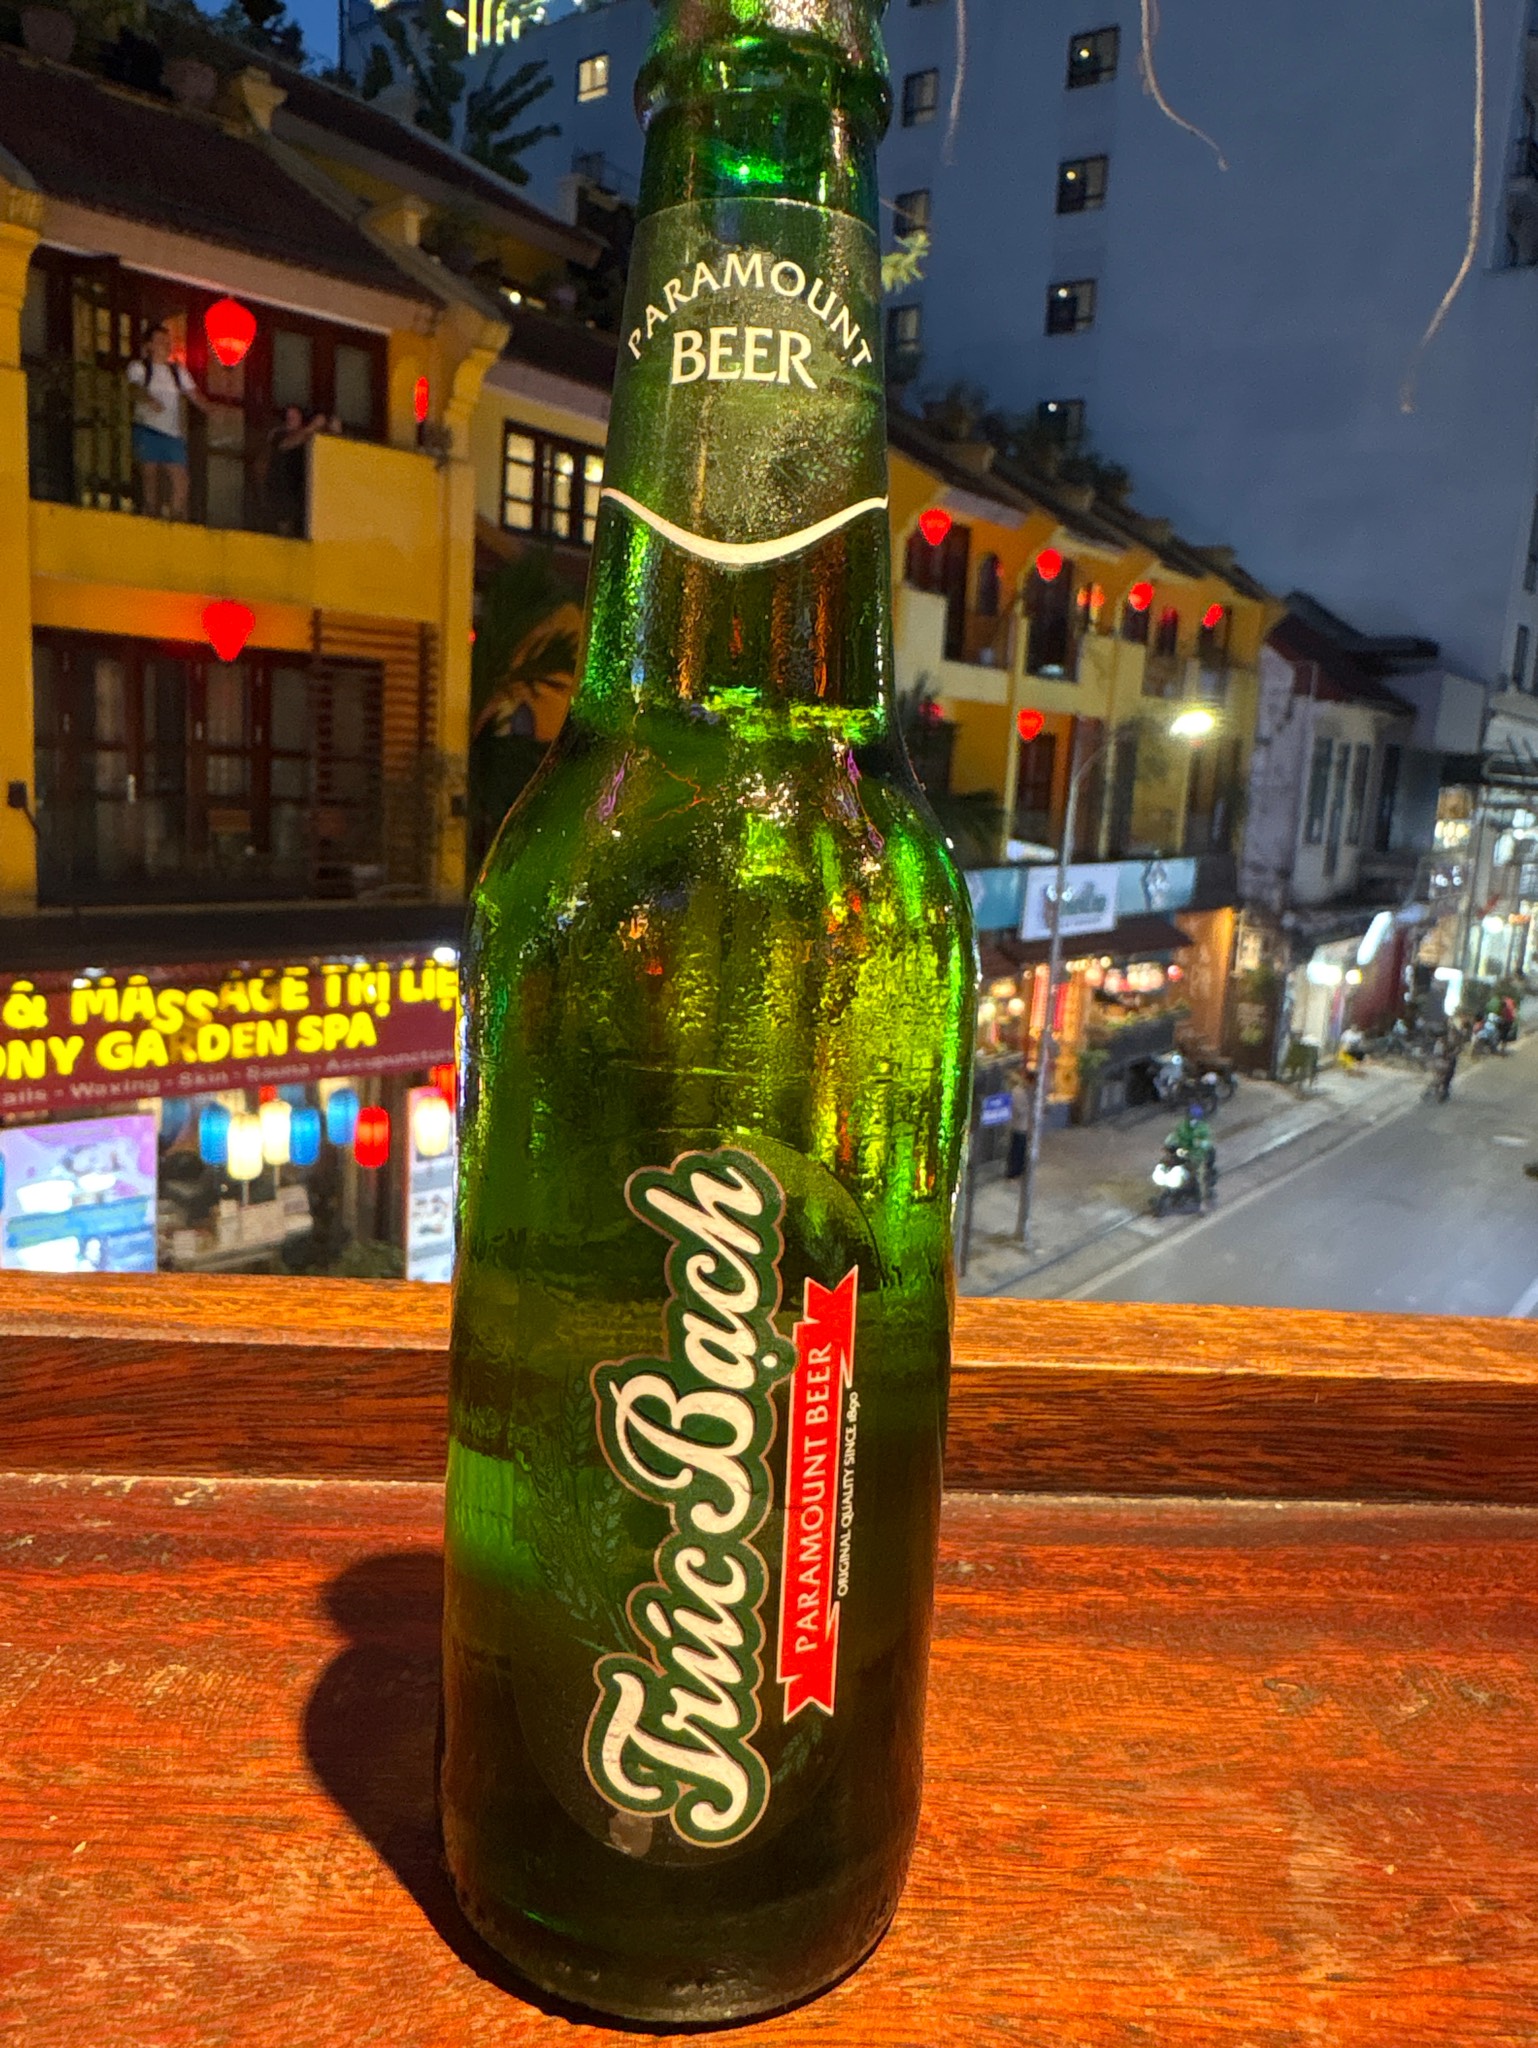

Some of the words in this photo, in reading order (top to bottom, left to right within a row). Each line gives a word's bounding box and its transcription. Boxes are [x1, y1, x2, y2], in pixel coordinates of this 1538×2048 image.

[627, 253, 873, 368] PARAMOUNT
[671, 325, 818, 390] BEER
[2, 979, 49, 1030] &
[70, 965, 310, 1035] MASSAGE
[0, 1034, 85, 1081] NY
[95, 1018, 288, 1071] GARDEN
[295, 1011, 378, 1053] SPA
[608, 1163, 777, 1535] Bạch
[804, 1341, 833, 1426] BEER
[846, 1391, 861, 1423] 1890
[843, 1424, 857, 1467] SINCE
[841, 1467, 855, 1529] QUALITY
[795, 1435, 828, 1654] PARAMOUNT
[837, 1528, 851, 1597] ORIGINAL
